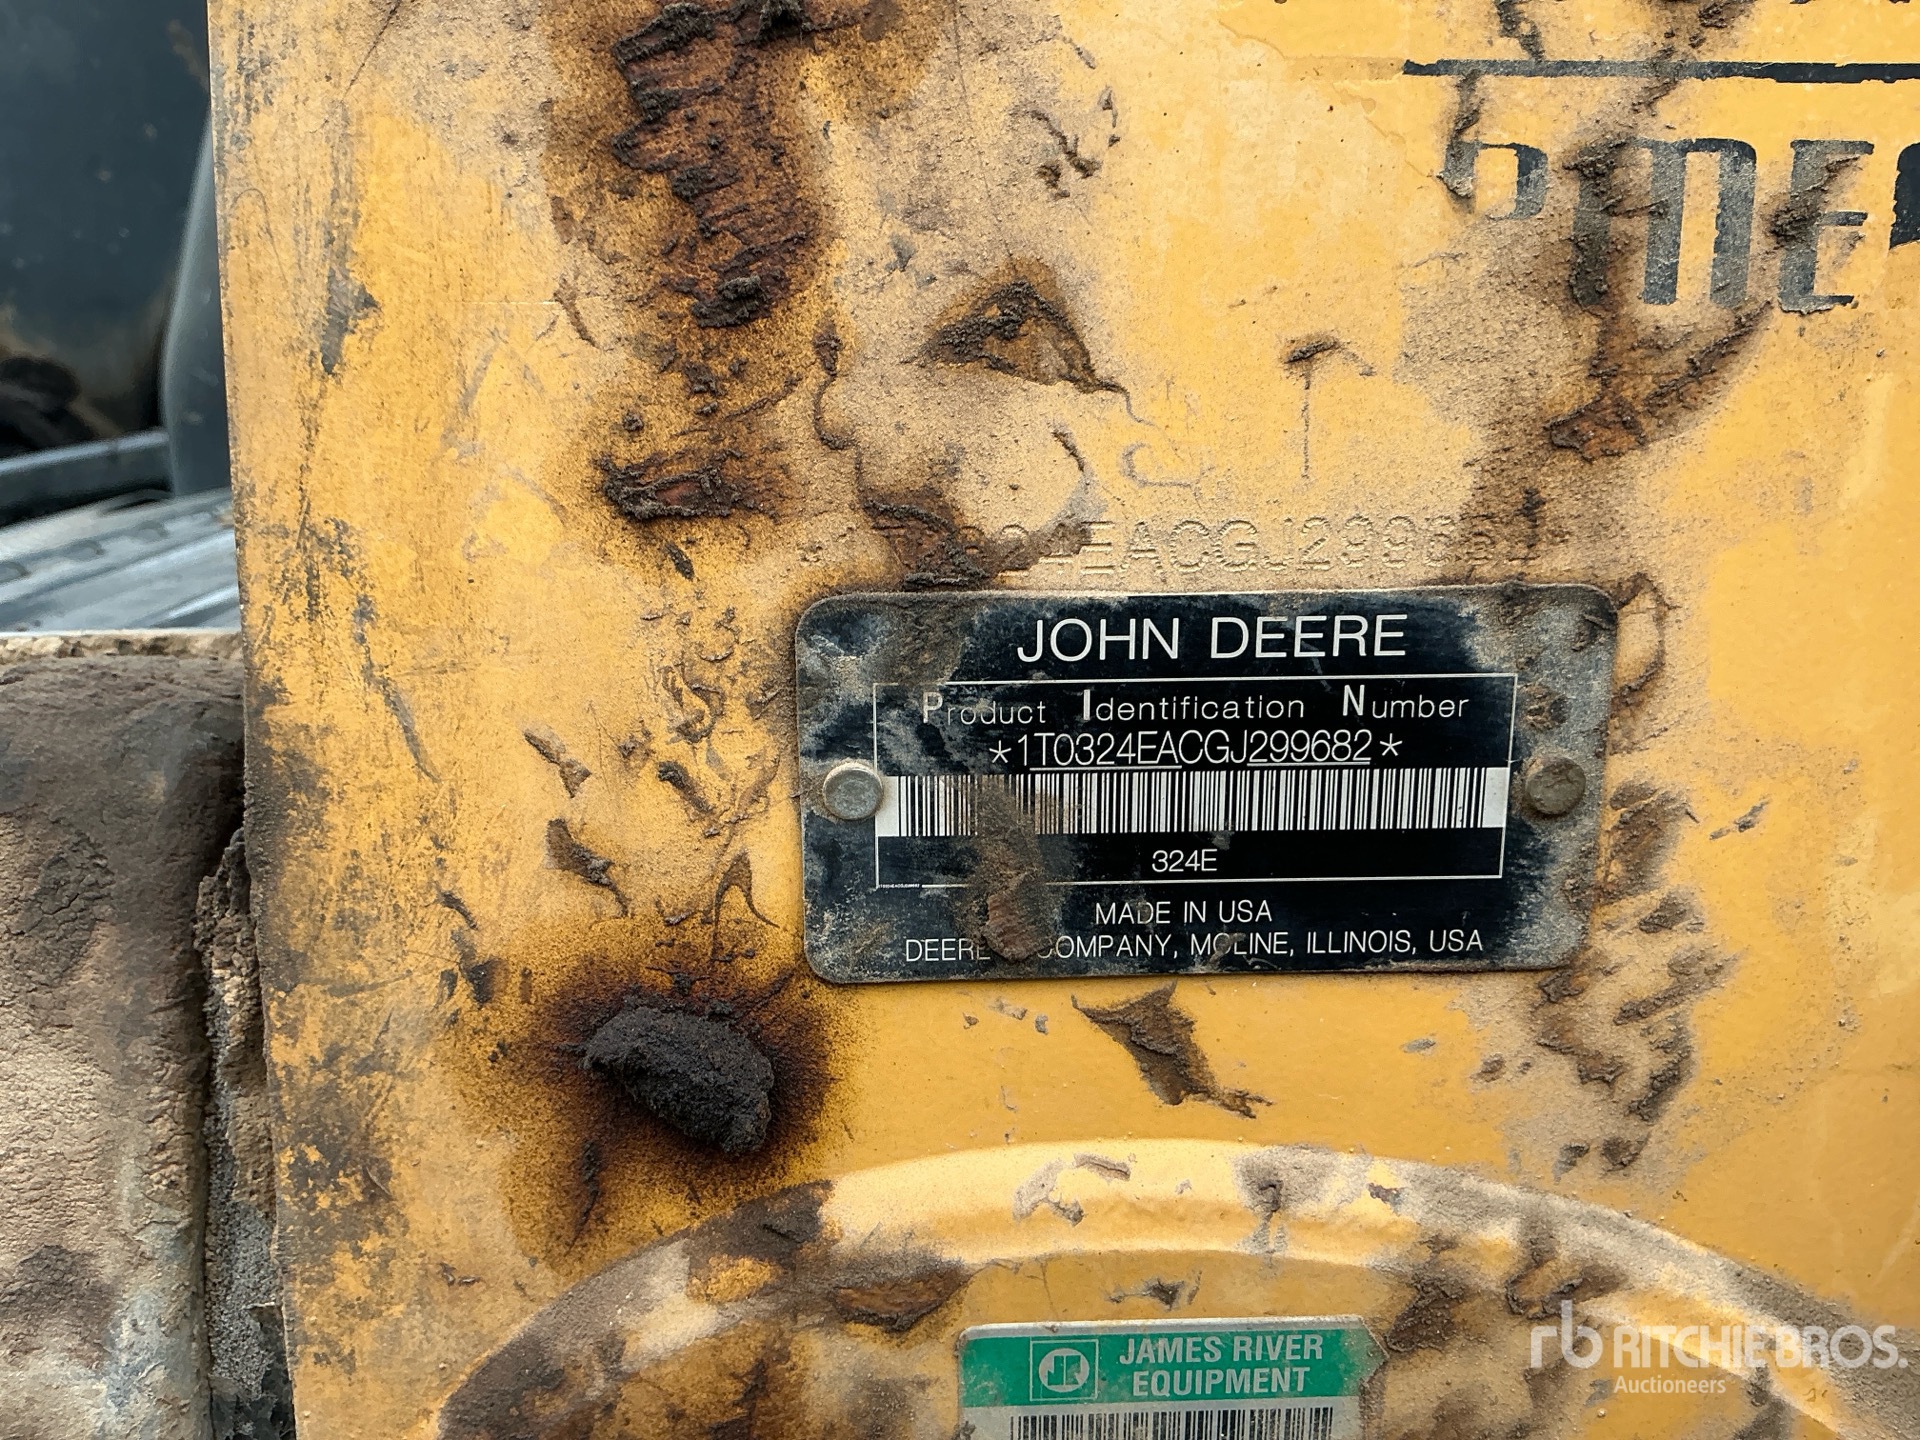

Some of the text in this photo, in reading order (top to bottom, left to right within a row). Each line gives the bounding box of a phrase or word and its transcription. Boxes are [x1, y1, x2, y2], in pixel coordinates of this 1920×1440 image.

[1016, 613, 1408, 663] JOHN DEERE
[921, 684, 1470, 726] Product Identification Number
[1151, 848, 1218, 873] 324E
[1095, 899, 1273, 925] MADE IN USA
[1190, 931, 1294, 957] MOLINE,
[1306, 929, 1417, 956] ILLINOIS,
[1428, 929, 1484, 952] USA
[1119, 1334, 1324, 1365] JAMES RIVER
[1132, 1366, 1311, 1397] EQUIPMENT
